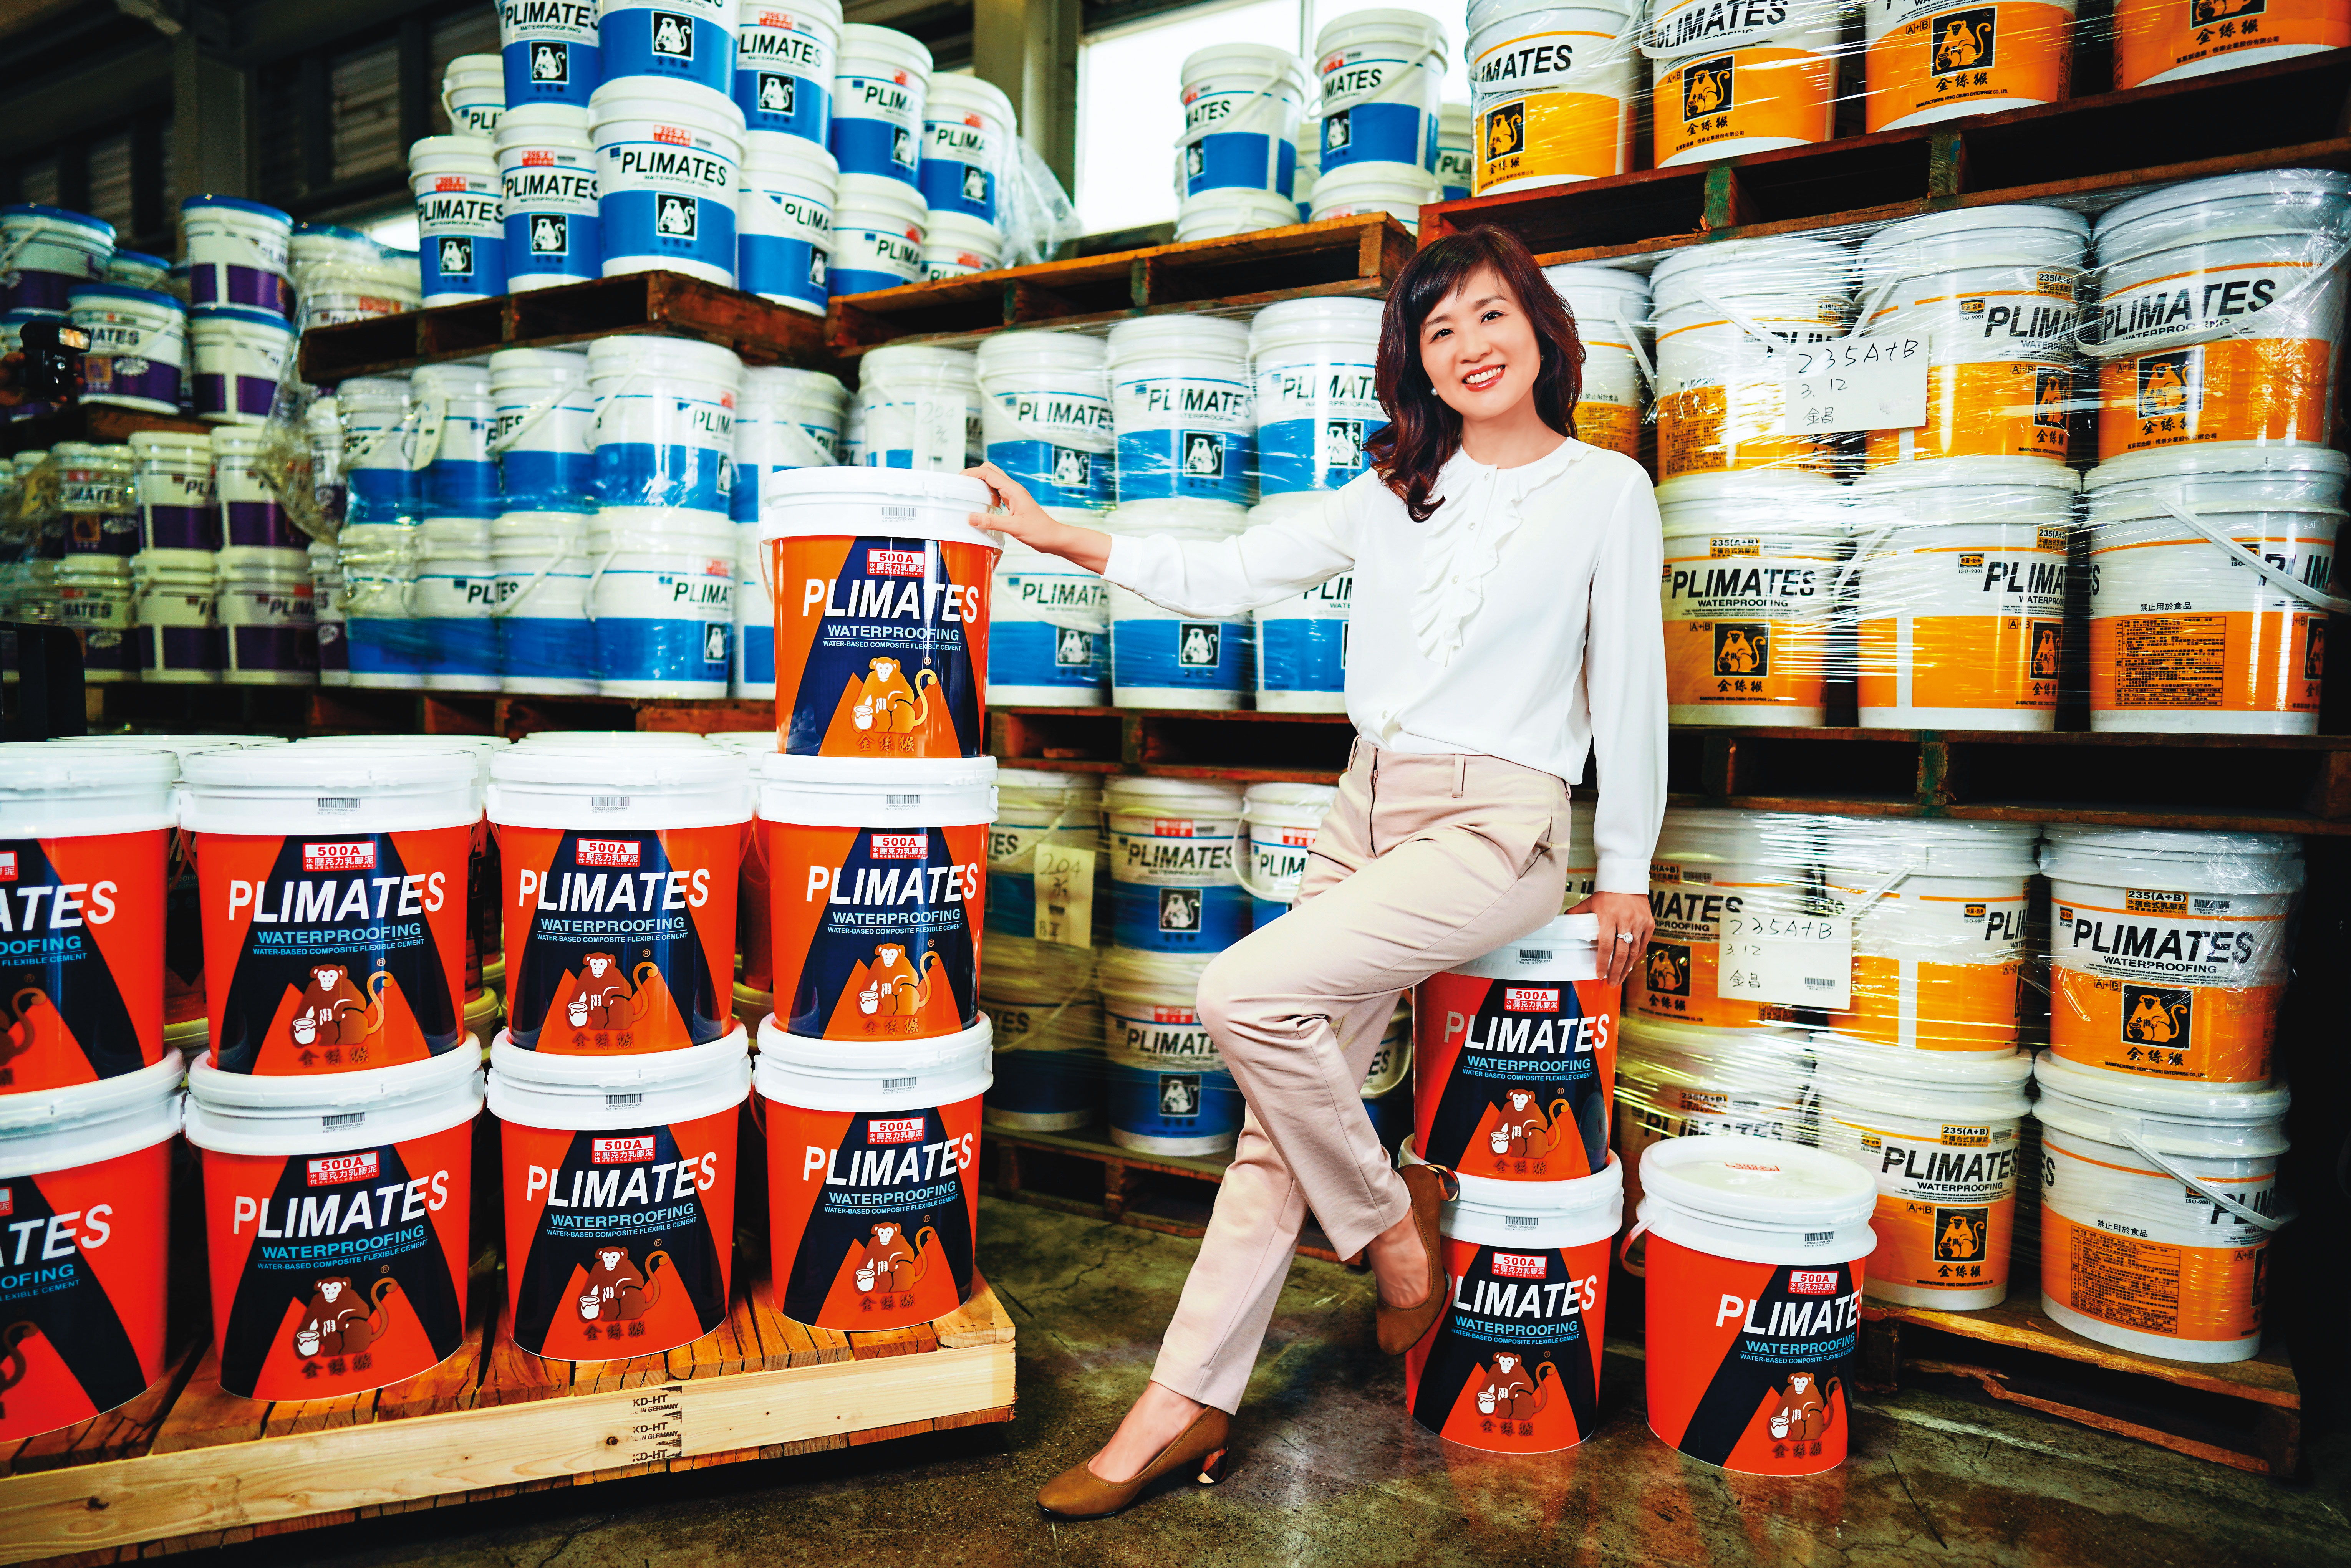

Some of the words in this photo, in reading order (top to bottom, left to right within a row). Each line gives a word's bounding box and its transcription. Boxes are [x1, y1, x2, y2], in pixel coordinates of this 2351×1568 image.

[1906, 18, 1930, 36] A+B
[2196, 18, 2258, 45] 金絲猴
[1936, 72, 1988, 93] 金絲猴
[1916, 98, 1944, 108] MANUFACTURER:
[1687, 116, 1728, 136] 金絲猴
[622, 152, 727, 186] PLIMATES
[505, 175, 599, 201] PLIMATES
[2104, 279, 2276, 341] PLIMATES
[1148, 388, 1251, 418] PLIMATES
[1712, 539, 1758, 547] 235(A+B)
[879, 552, 914, 563] 500A
[1672, 568, 1816, 599] PLIMATES
[803, 579, 979, 623] PLIMATES
[2141, 601, 2192, 612] 禁止用於食品
[828, 624, 959, 641] WATERPROOFING
[1690, 622, 1712, 631] A+B
[2008, 619, 2031, 629] A+B
[1717, 679, 1763, 692] 金絲猴
[857, 734, 915, 752] 金絲猴
[588, 843, 627, 853] 500A
[882, 837, 916, 846] 500A
[318, 845, 361, 856] 500A
[1128, 844, 1232, 869] PLIMATES
[519, 868, 710, 912] PLIMATES
[807, 863, 978, 906] PLIMATES
[229, 871, 445, 923] PLIMATES
[2128, 890, 2187, 903] 235(A+B)
[540, 917, 684, 932] WATERPROOFING
[833, 909, 960, 924] WATERPROOFING
[257, 923, 420, 944] WATERPROOFING
[537, 934, 581, 943] WATER-BASED
[582, 935, 626, 943] COMPOSITE
[627, 934, 660, 942] FLEXIBLE
[661, 932, 688, 940] CEMENT
[915, 925, 942, 933] FLEXIBLE
[1730, 918, 1832, 940] 235A+B
[253, 947, 307, 955] WATER-BASED
[309, 946, 358, 954] COMPOSITE
[360, 942, 395, 951] FLEXIBLE
[397, 939, 424, 948] CEMENT
[2073, 918, 2255, 964] PLIMATES
[2, 957, 48, 966] FLEXIBLE
[50, 953, 87, 963] CEMENT
[2104, 955, 2217, 974] WATERPROOFING
[2094, 980, 2121, 992] A+B
[1516, 991, 1548, 1000] 500A
[863, 1018, 919, 1035] 金絲猴
[1444, 1010, 1610, 1054] PLIMATES
[572, 1031, 635, 1050] 金絲猴
[1467, 1055, 1591, 1070] WATERPROOFING
[2127, 1046, 2184, 1066] 金絲猴
[1463, 1069, 1506, 1079] WATER-BASED
[1507, 1073, 1544, 1081] COMPOSITE
[1573, 1072, 1592, 1080] CEMENT
[879, 1121, 913, 1131] 500A
[1943, 1126, 1989, 1136] 235(A+B)
[605, 1140, 643, 1150] 500A
[321, 1156, 364, 1171] 500A
[803, 1132, 973, 1186] PLIMATES
[1494, 1159, 1547, 1176] 金絲猴
[1882, 1146, 2019, 1182] PLIMATES
[526, 1152, 717, 1208] PLIMATES
[1917, 1182, 2003, 1192] WATERPROOFING
[829, 1181, 956, 1204] WATERPROOFING
[233, 1170, 449, 1238] PLIMATES
[871, 1206, 910, 1214] COMPOSITE
[911, 1200, 938, 1210] FLEXIBLE
[938, 1194, 958, 1205] CEMENT
[1907, 1202, 1933, 1215] A+B
[551, 1203, 694, 1227] WATERPROOFING
[547, 1229, 594, 1237] WATER-BASED
[595, 1229, 638, 1237] COMPOSITE
[640, 1224, 671, 1234] FLEXIBLE
[672, 1217, 697, 1228] CEMENT
[2097, 1219, 2148, 1238] 禁止用於食品
[262, 1225, 424, 1259] WATERPROOFING
[257, 1262, 311, 1270] WATER-BASED
[313, 1257, 362, 1269] COMPOSITE
[364, 1248, 399, 1263] FLEXIBLE
[400, 1239, 428, 1253] CEMENT
[1504, 1256, 1536, 1267] 500A
[2235, 1250, 2254, 1261] A+B
[1800, 1273, 1829, 1283] 500A
[1938, 1264, 1981, 1278] 金絲猴
[42, 1279, 80, 1293] CEMENT
[1716, 1283, 1864, 1337] PLIMATES
[1455, 1315, 1577, 1336] WATERPROOFING
[1451, 1328, 1493, 1342] WATER-BASED
[1493, 1336, 1531, 1345] COMPOSITE
[1531, 1336, 1559, 1344] FLEXIBLE
[1559, 1333, 1579, 1342] CEMENT
[1745, 1332, 1855, 1354] WATERPROOFING
[1740, 1354, 1787, 1364] WATER-BASED
[1788, 1354, 1822, 1364] COMPOSITE
[1823, 1351, 1843, 1362] FLEXIBLE
[1844, 1344, 1855, 1356] CEMENT
[633, 1394, 668, 1407] KD-HT
[648, 1403, 678, 1412] GERMANY
[633, 1422, 668, 1434] KD-HT
[633, 1449, 668, 1462] KD-HT
